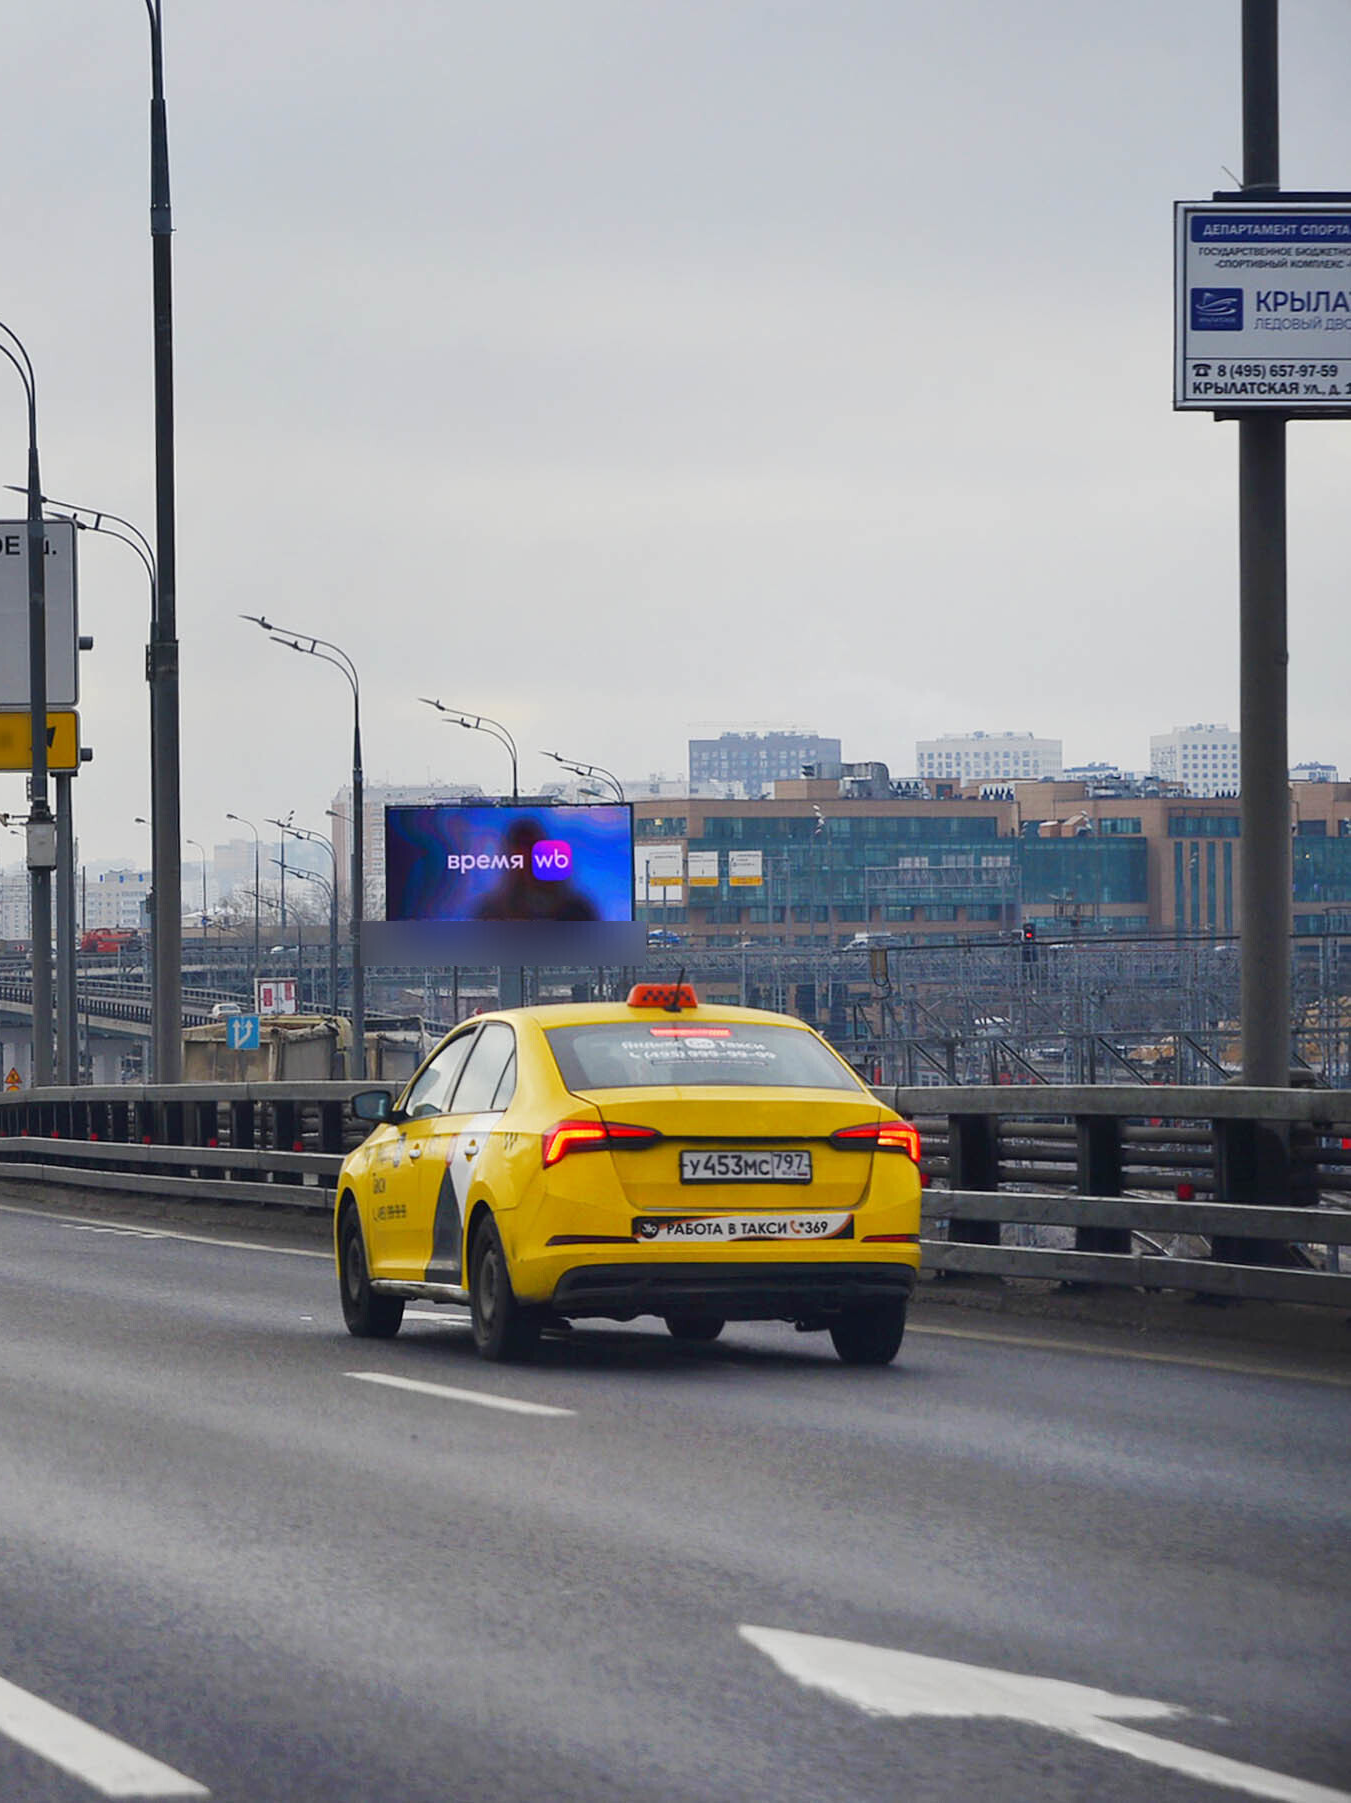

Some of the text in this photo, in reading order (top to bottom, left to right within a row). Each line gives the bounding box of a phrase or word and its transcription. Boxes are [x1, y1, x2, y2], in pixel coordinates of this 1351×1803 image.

[1202, 224, 1350, 236] ДЕПАРТАМЕНТ СПОРТА
[1198, 247, 1292, 257] ГОСУДАРСТВЕННОЕ
[1255, 291, 1351, 312] КРЫЛА
[1254, 316, 1322, 331] ЛЕДОВЫЙ
[1217, 364, 1339, 379] 8 (495) 657-97-59
[1193, 382, 1299, 395] КРЫЛАТСКАЯ
[447, 848, 569, 874] время wb
[773, 1153, 804, 1170] 797
[666, 1222, 723, 1235] РАБОТА
[728, 1223, 737, 1235] В
[741, 1222, 787, 1235] ТАКСИ
